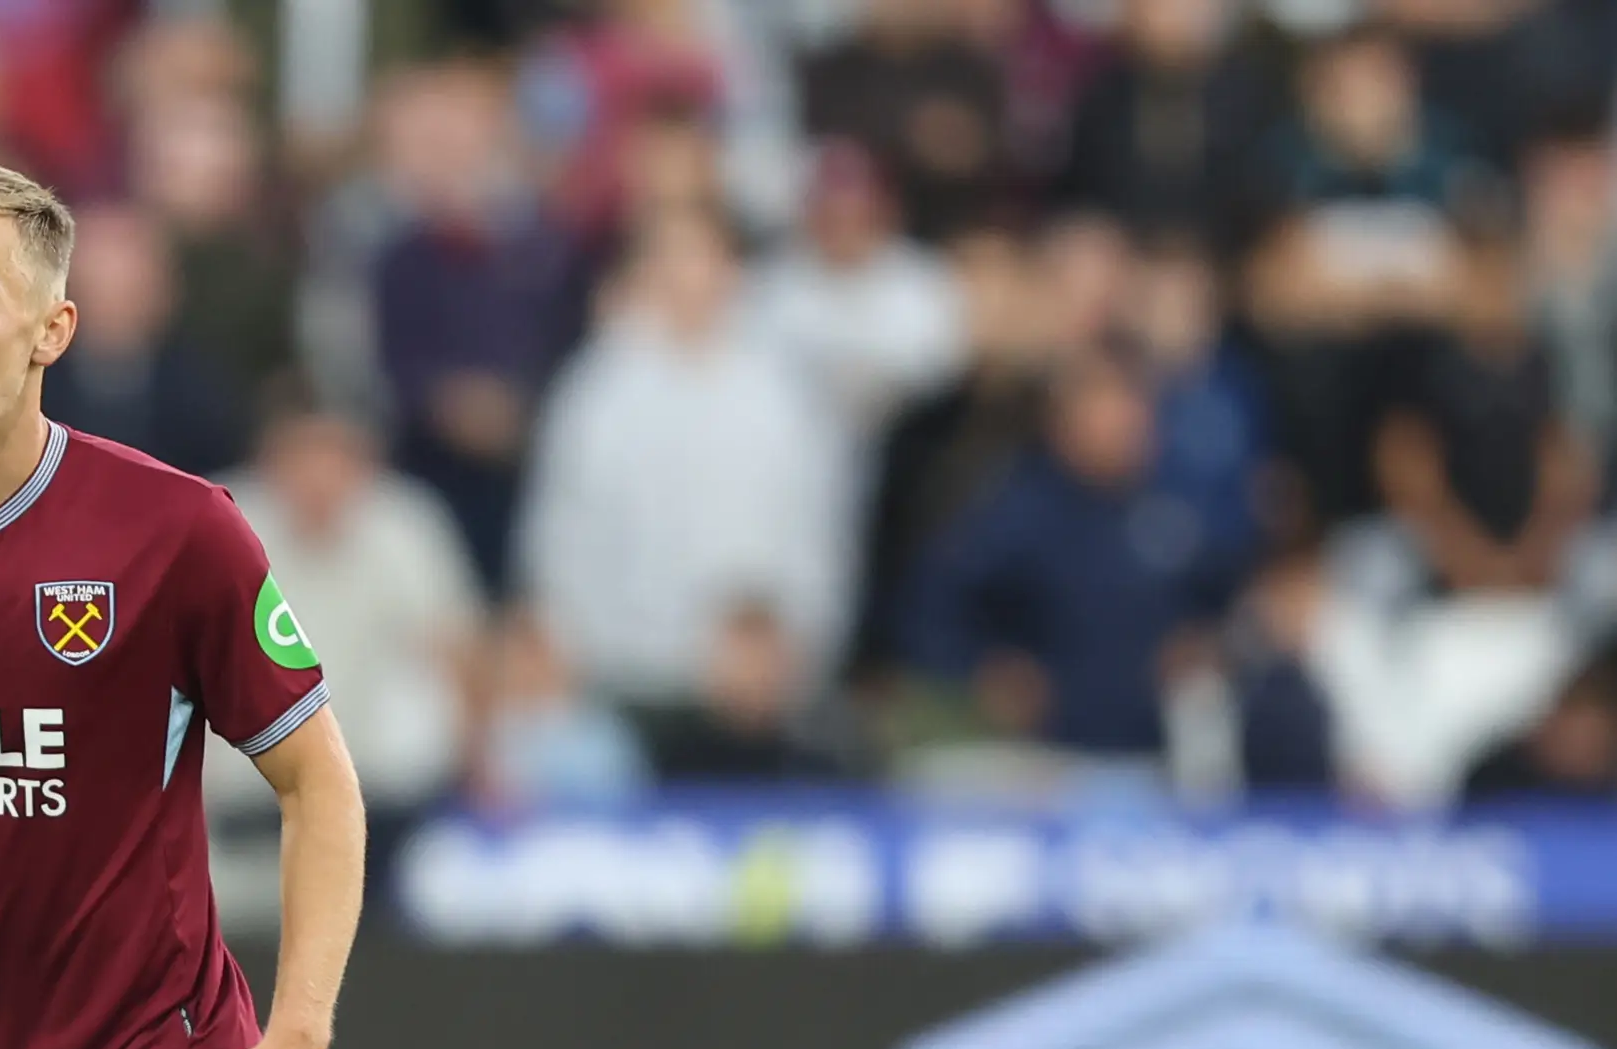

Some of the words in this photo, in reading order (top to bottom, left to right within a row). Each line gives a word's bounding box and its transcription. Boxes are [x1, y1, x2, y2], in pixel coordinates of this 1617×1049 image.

[44, 585, 75, 596] WEST
[76, 585, 106, 596] HAM
[56, 594, 93, 602] UNITED
